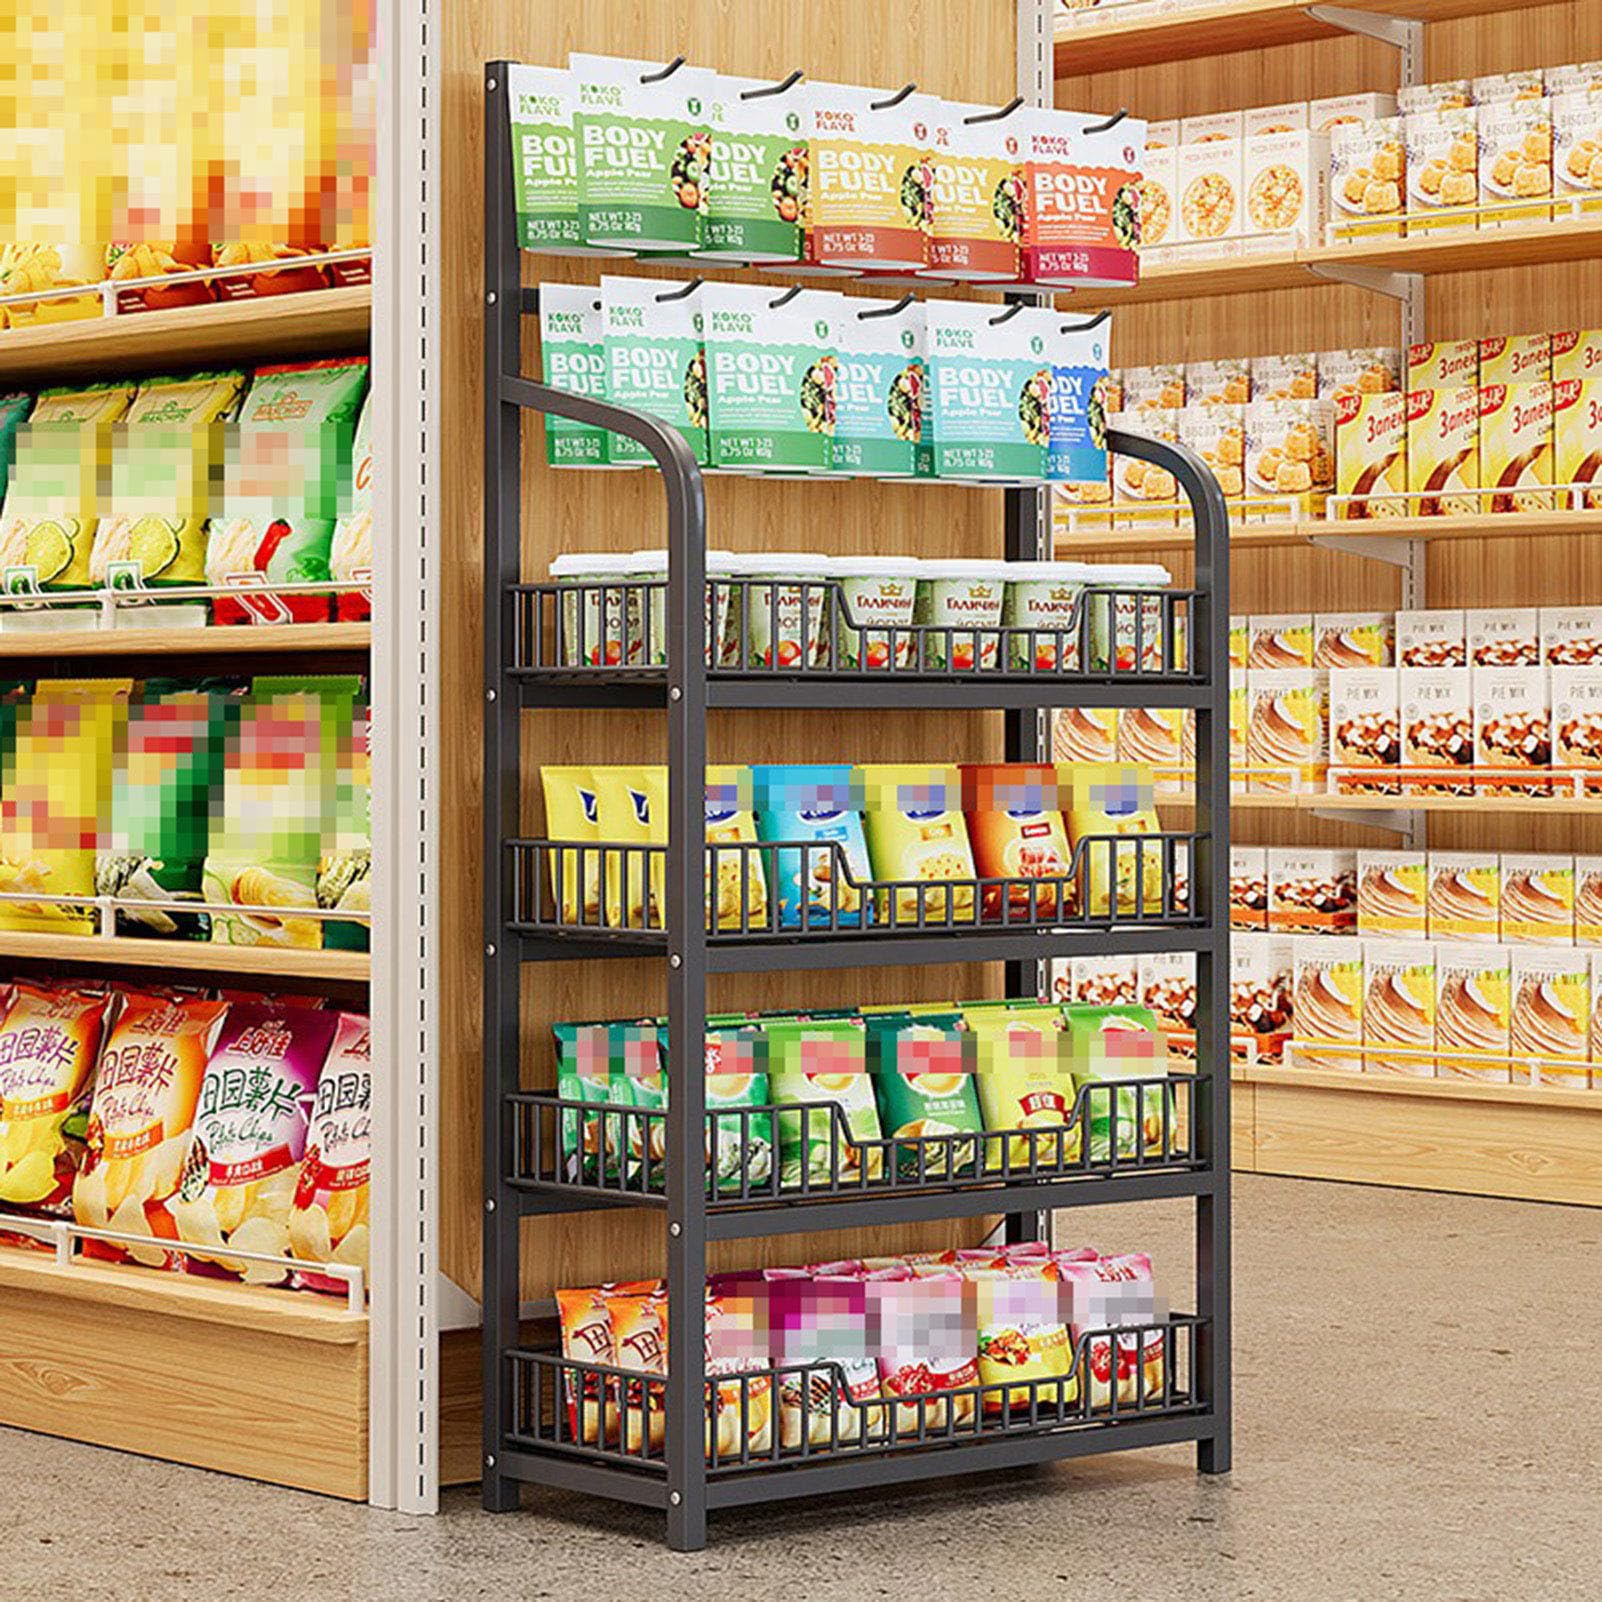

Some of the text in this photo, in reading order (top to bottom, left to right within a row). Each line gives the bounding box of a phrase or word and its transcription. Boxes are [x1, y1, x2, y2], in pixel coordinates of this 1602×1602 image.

[583, 125, 666, 150] BODY
[584, 147, 666, 171] FUEL
[711, 141, 766, 165] ODY
[818, 149, 896, 173] BODY
[711, 162, 766, 184] UEL
[819, 170, 896, 194] FUEL
[933, 166, 989, 188] ODY
[1035, 172, 1107, 196] BODY
[933, 186, 989, 207] UEL
[1035, 194, 1108, 214] FUEL
[548, 322, 582, 334] FLAVE
[551, 353, 605, 374] BOD
[611, 347, 680, 370] BODY
[715, 352, 796, 376] BODY
[612, 368, 680, 390] FUEL
[838, 363, 882, 384] ODY
[938, 366, 1015, 389] BODY
[716, 374, 795, 396] FUEL
[837, 383, 883, 404] UEL
[940, 387, 1014, 408] FUEL
[228, 1026, 293, 1061] 上好佳
[237, 1115, 274, 1151] Chips
